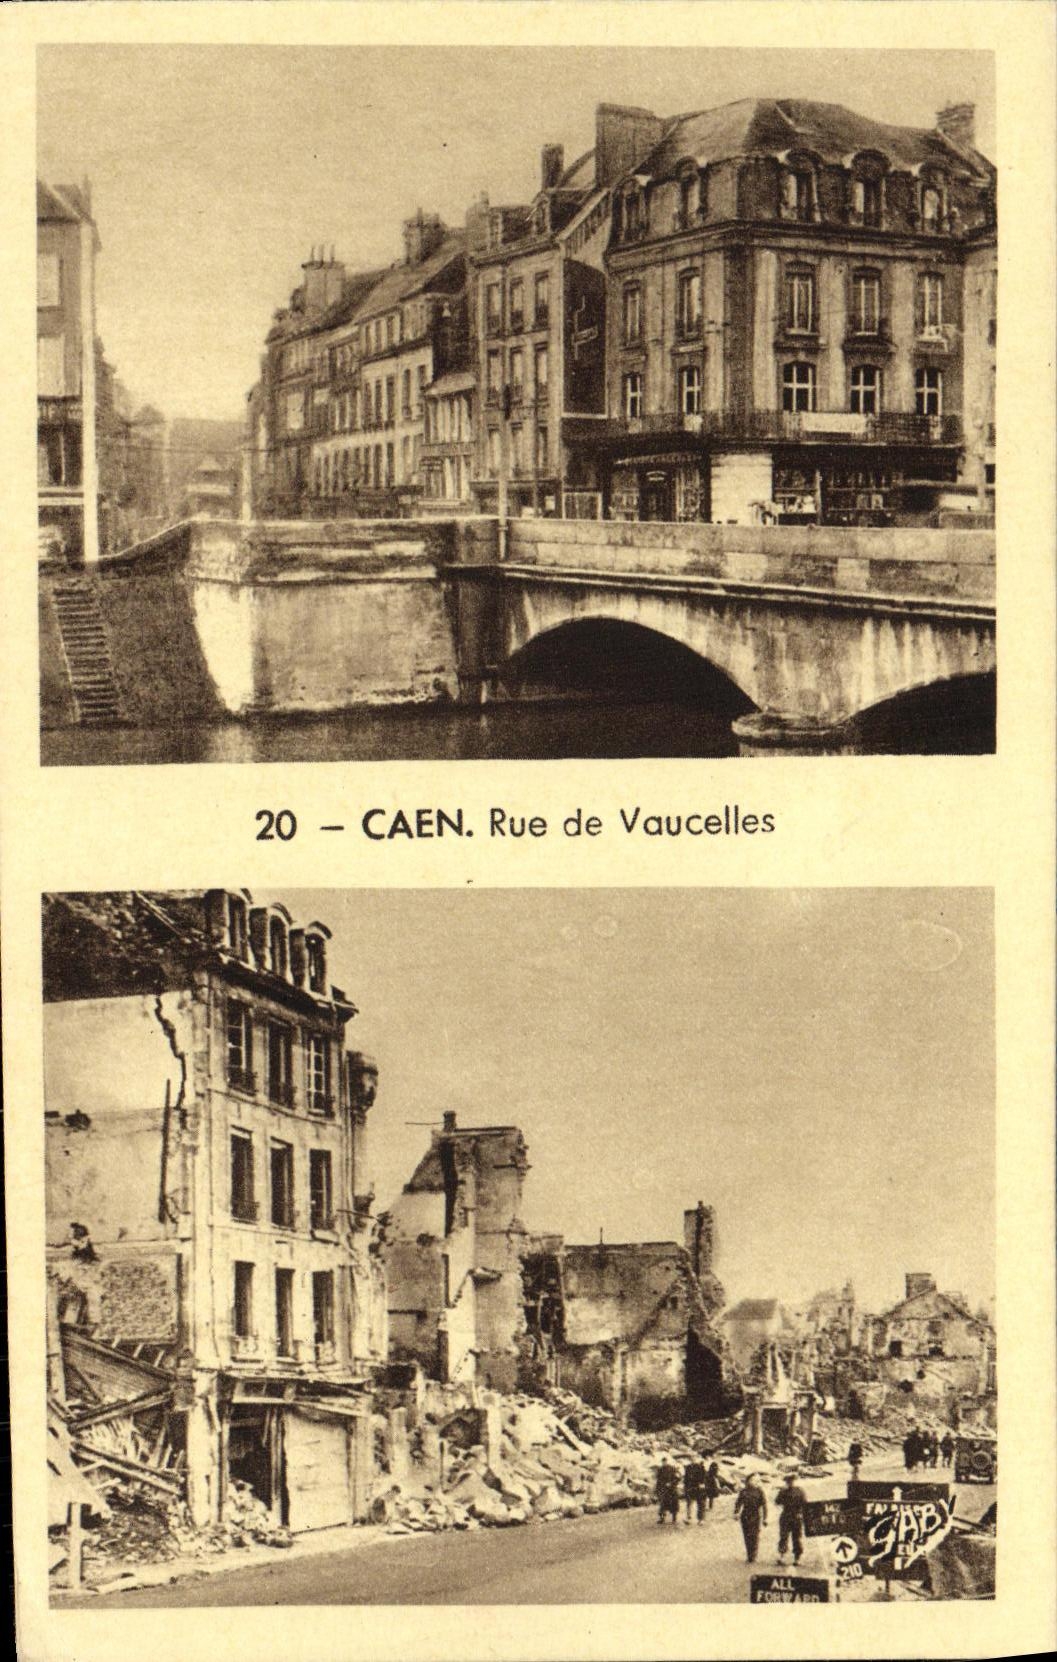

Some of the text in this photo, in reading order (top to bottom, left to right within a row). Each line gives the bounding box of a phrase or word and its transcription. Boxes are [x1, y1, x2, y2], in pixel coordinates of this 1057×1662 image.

[841, 1562, 863, 1580] 210
[771, 1578, 795, 1591] ALL
[756, 1590, 821, 1603] FORWARD
